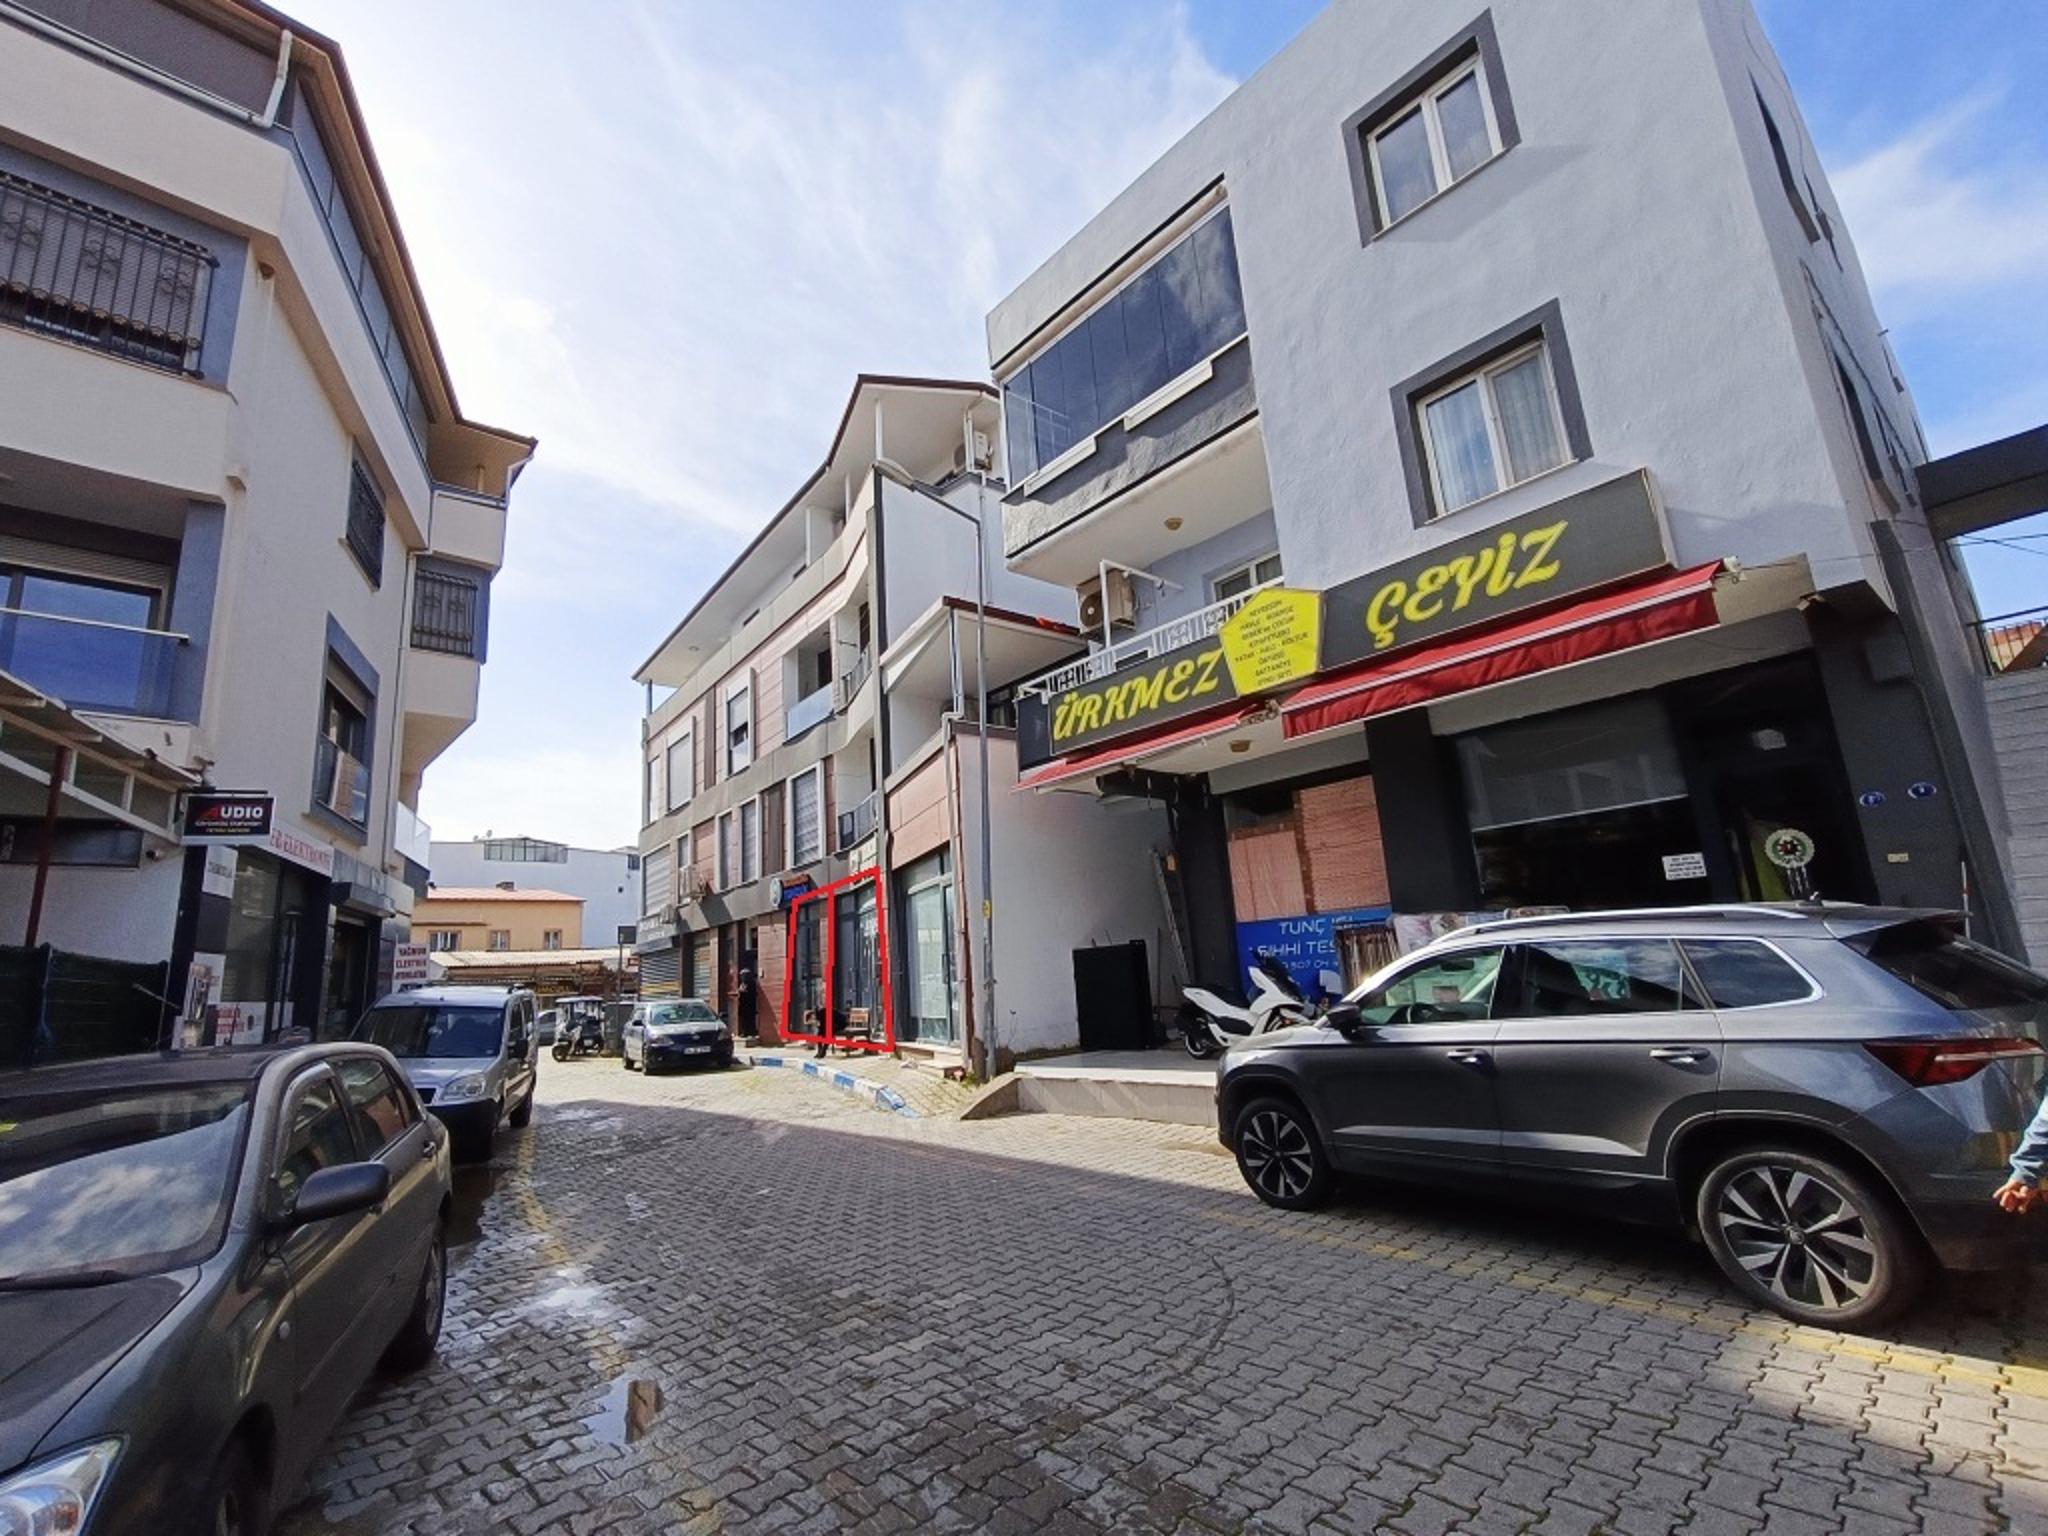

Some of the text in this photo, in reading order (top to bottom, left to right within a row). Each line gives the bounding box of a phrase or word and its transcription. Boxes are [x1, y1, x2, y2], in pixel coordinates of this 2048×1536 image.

[1366, 520, 1568, 649] ÇEYİZ
[1053, 649, 1223, 740] ÜRKMEZ
[1280, 919, 1325, 936] TUNÇ
